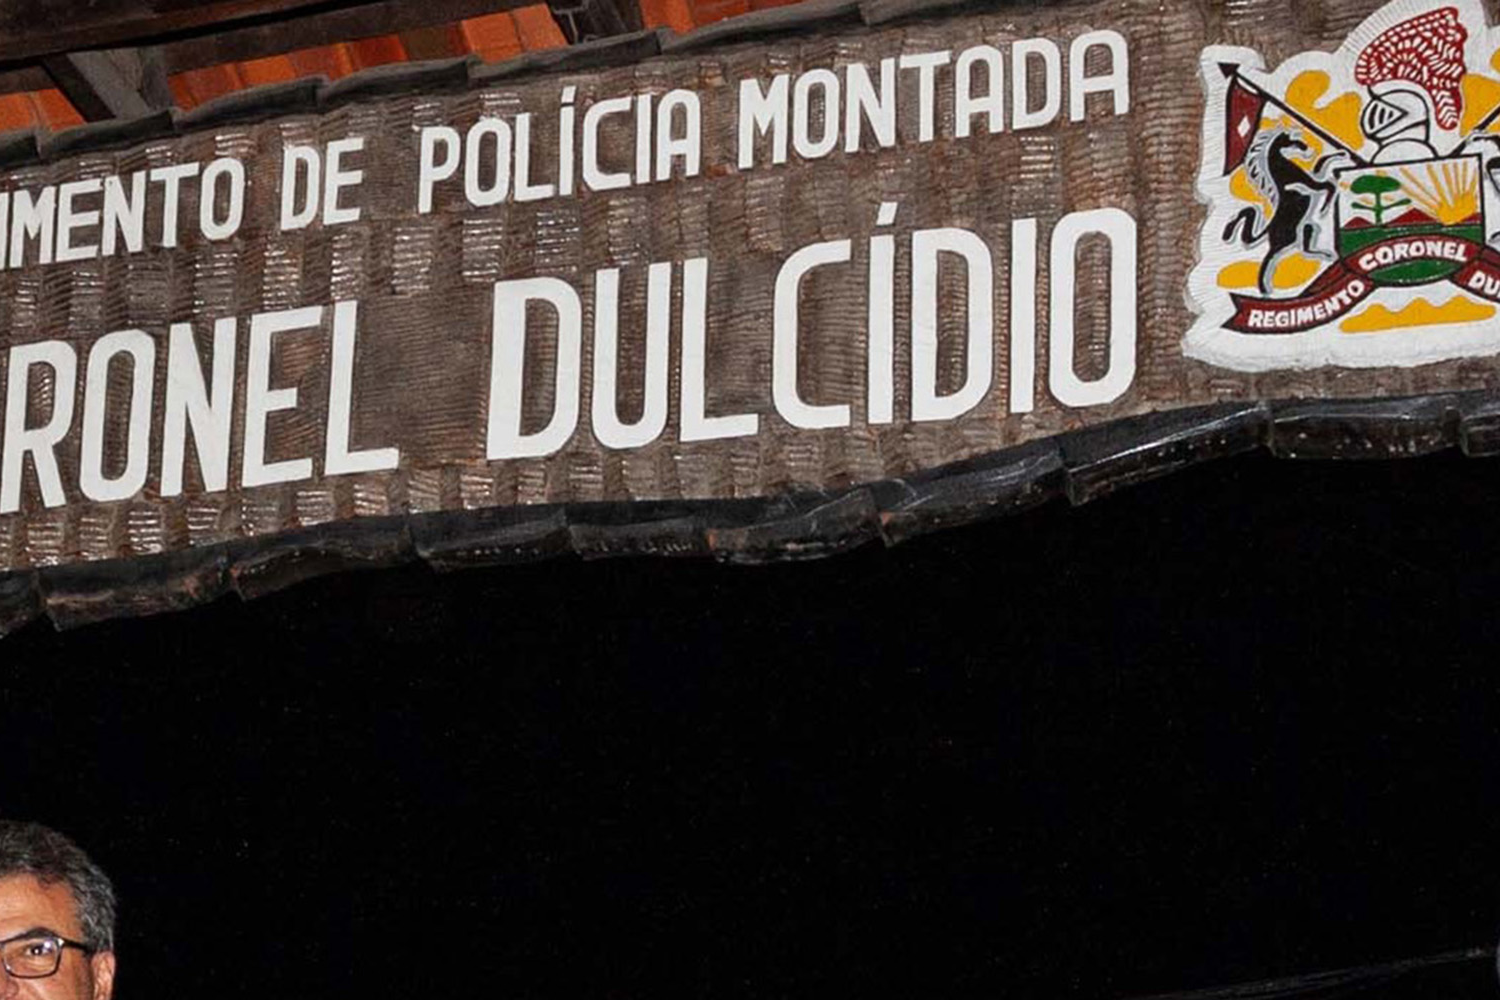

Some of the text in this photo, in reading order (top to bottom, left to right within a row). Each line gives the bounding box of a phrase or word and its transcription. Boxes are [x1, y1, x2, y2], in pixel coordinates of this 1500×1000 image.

[280, 137, 364, 232] DE
[418, 87, 701, 214] POLÍCIA
[738, 29, 1130, 170] MONTADA
[486, 201, 1138, 461] DULCÍDIO
[1247, 240, 1500, 328] REGIMENTO CORONEL DU
